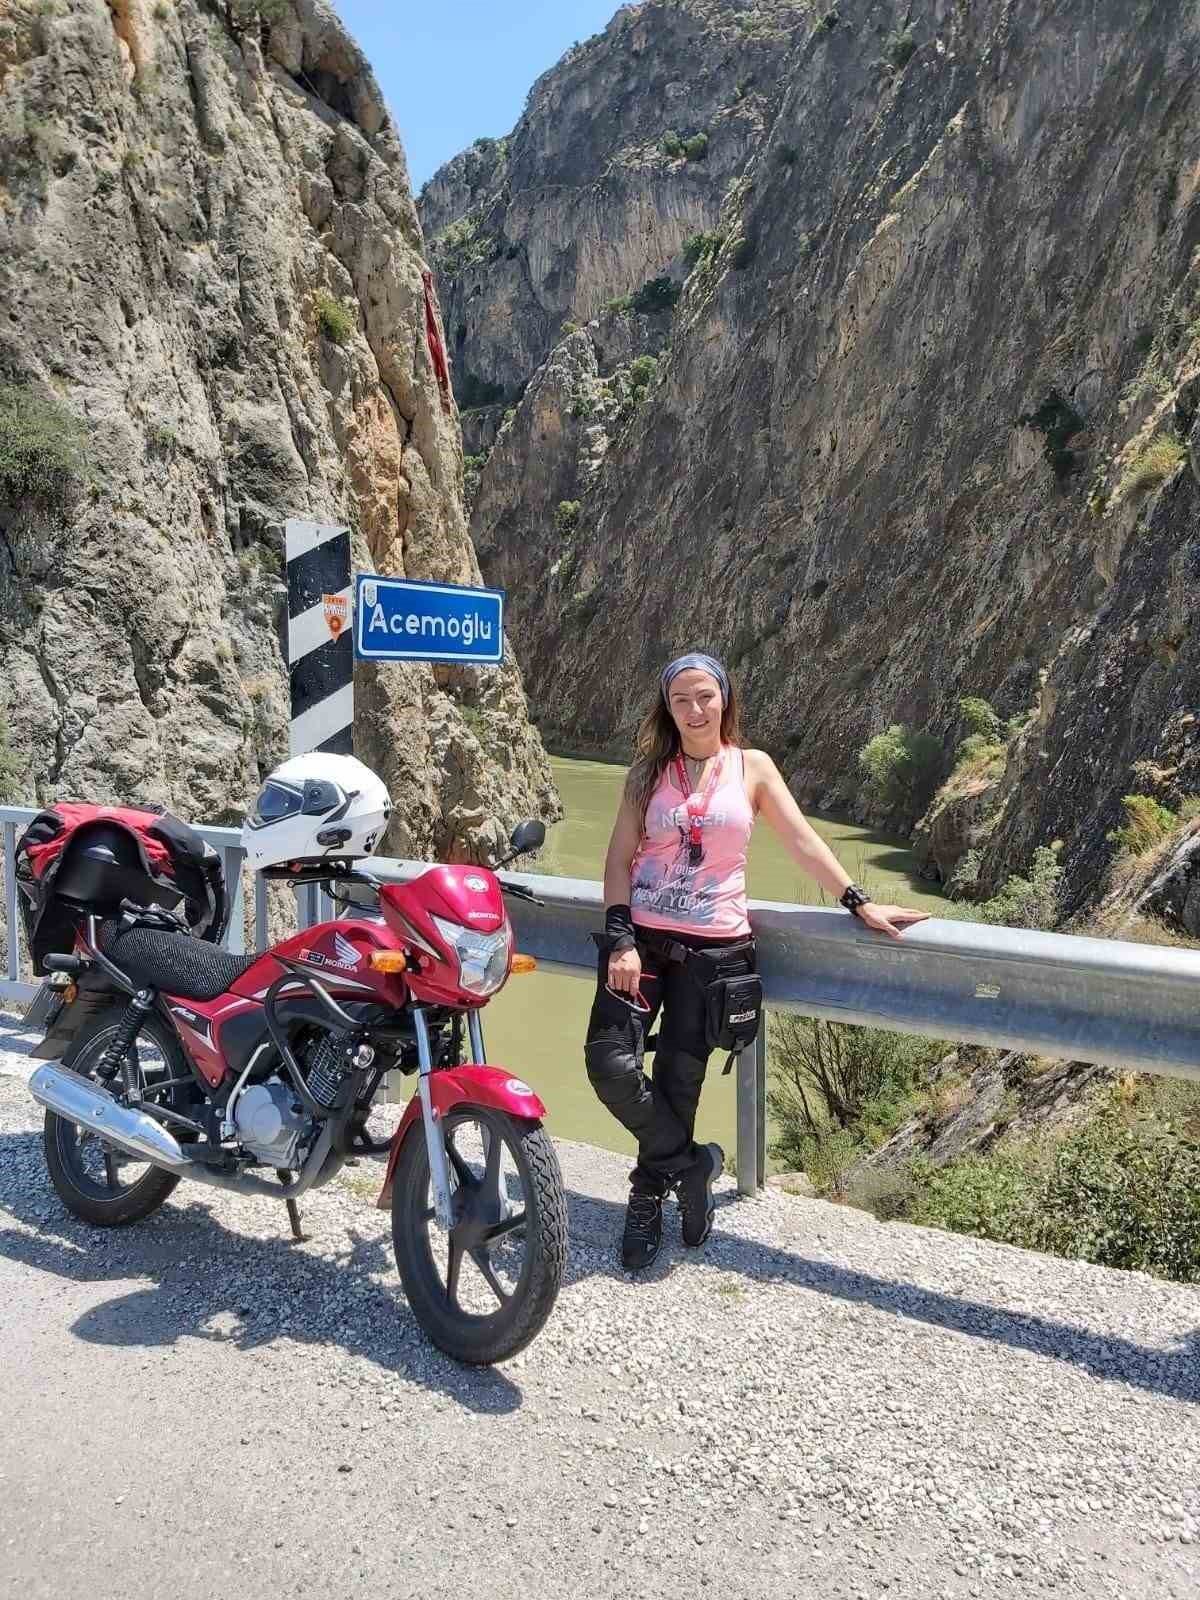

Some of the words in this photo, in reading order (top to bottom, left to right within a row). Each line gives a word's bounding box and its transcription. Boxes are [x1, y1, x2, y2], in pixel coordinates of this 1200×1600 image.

[368, 603, 492, 645] Acemoğlu
[661, 812, 728, 827] NEER
[324, 958, 359, 973] HONDA
